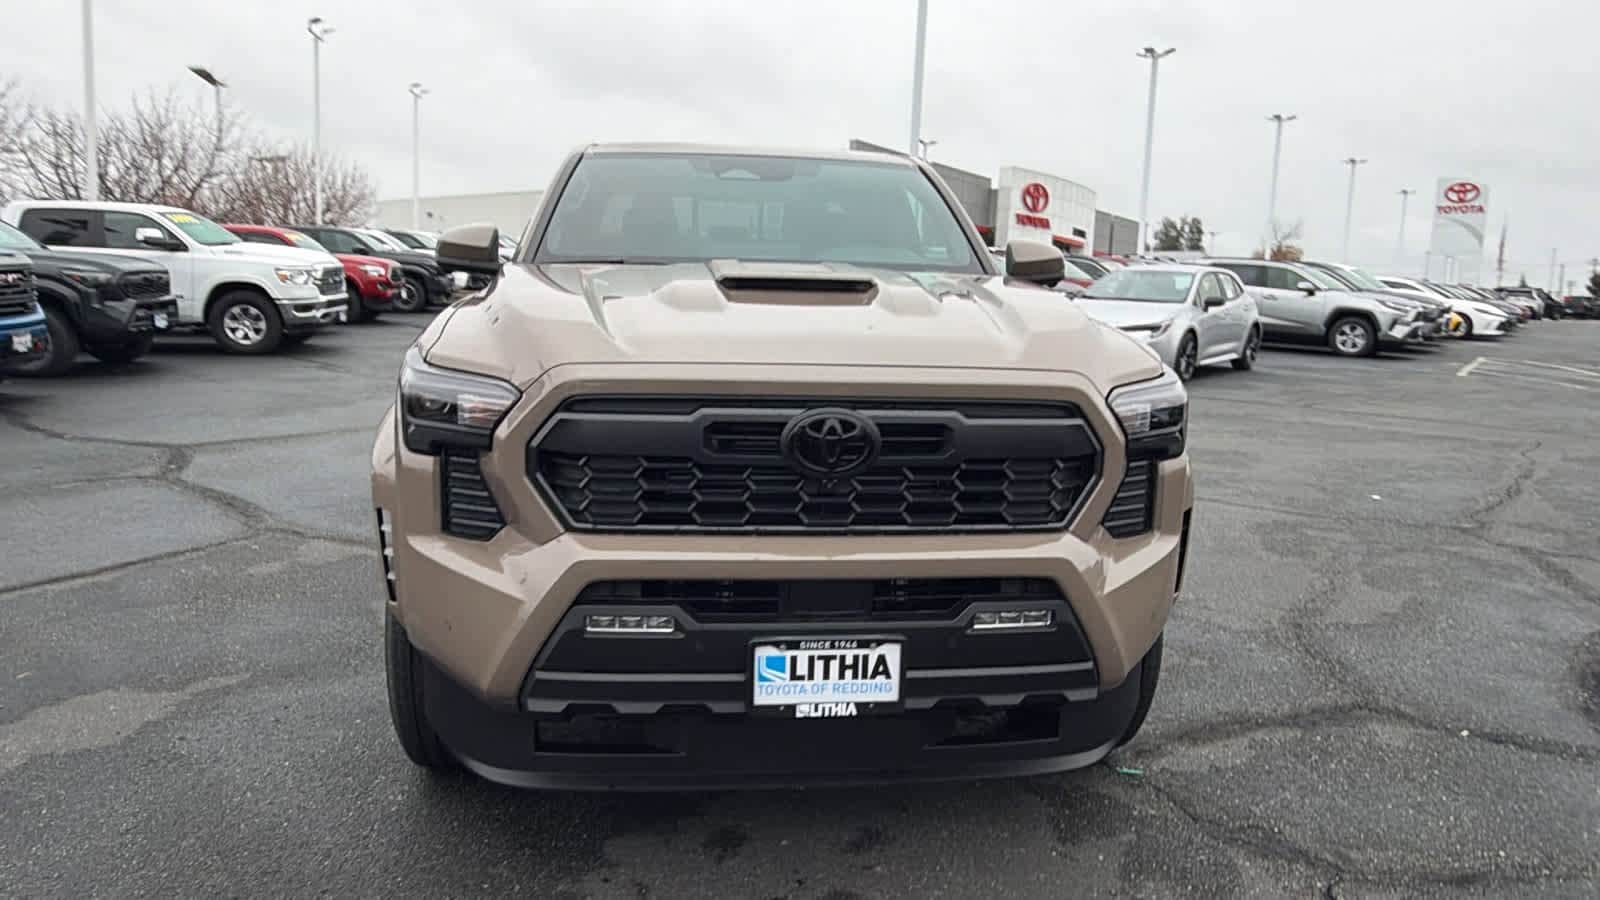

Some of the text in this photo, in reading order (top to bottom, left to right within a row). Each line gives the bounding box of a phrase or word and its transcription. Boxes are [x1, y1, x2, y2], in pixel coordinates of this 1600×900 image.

[1436, 205, 1485, 214] TOYOTA
[799, 640, 830, 649] SINCE
[789, 654, 892, 681] LITHIA
[758, 682, 893, 696] TOYOTA OF REDDING
[809, 702, 857, 717] LITHIA
